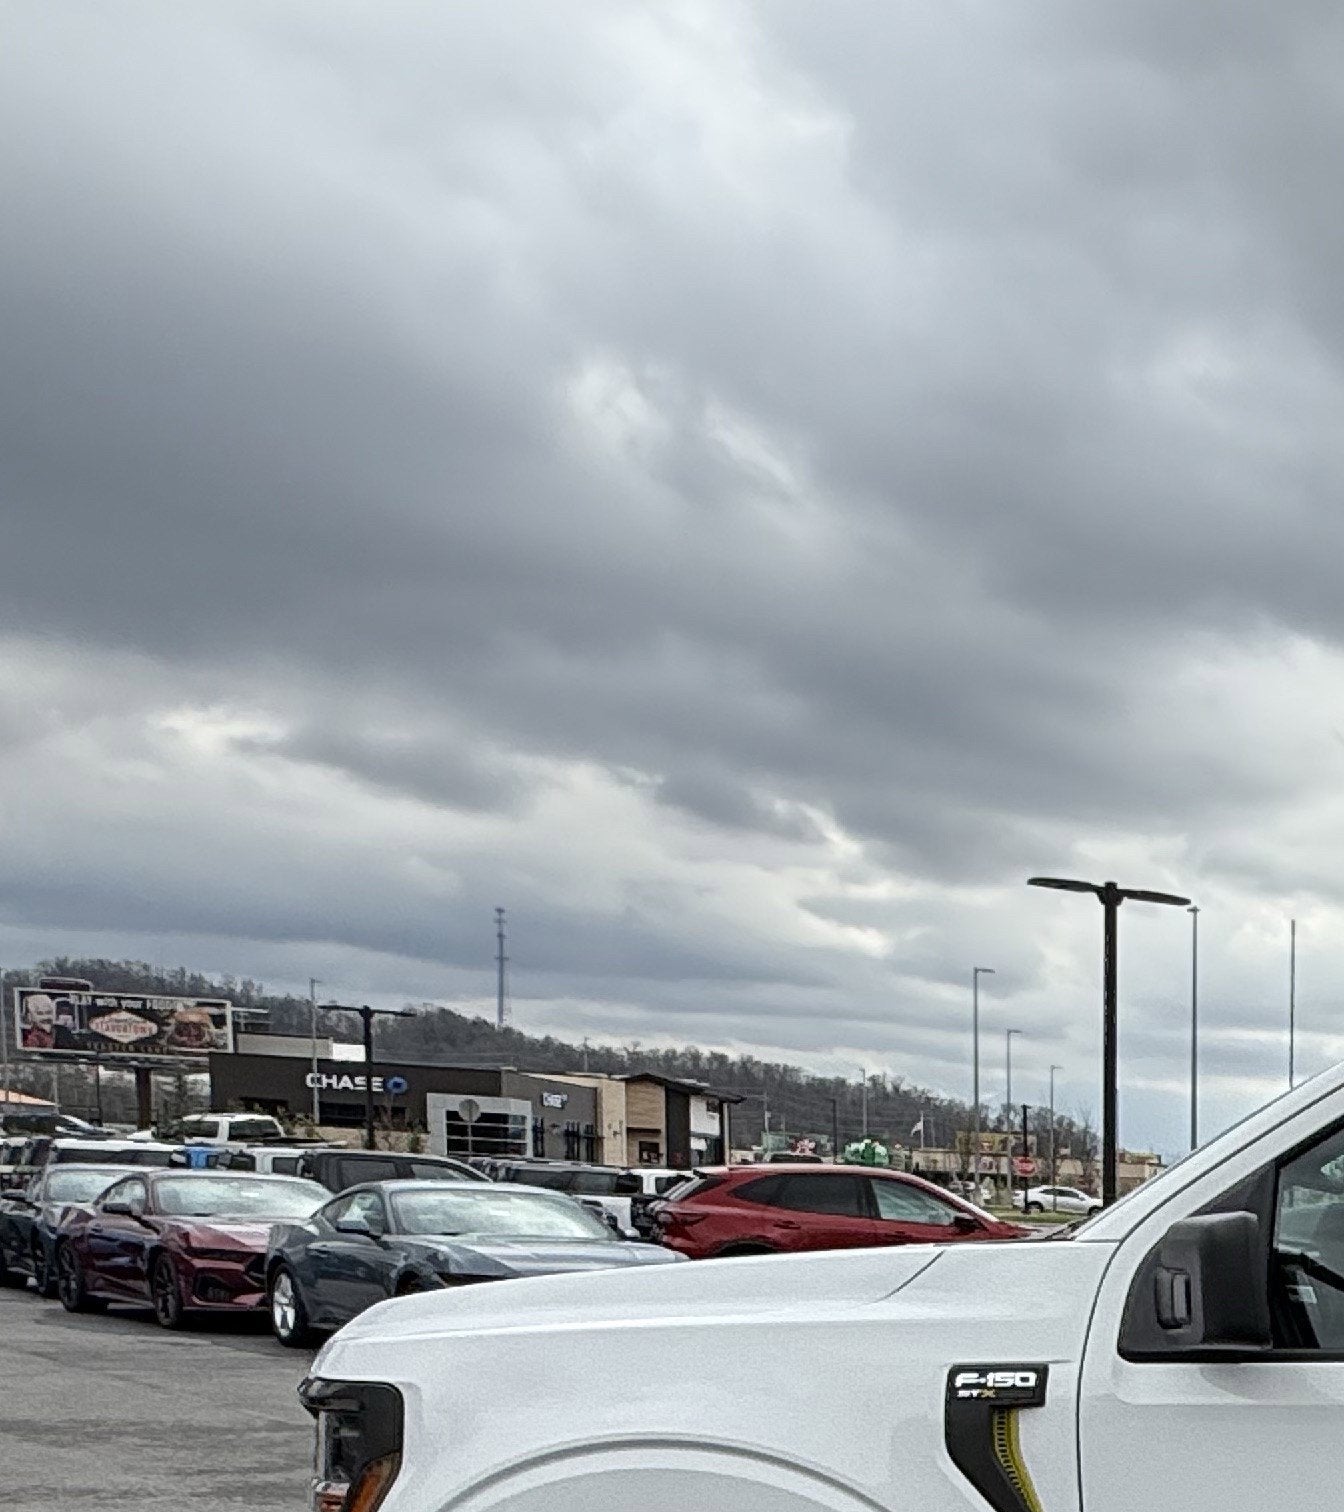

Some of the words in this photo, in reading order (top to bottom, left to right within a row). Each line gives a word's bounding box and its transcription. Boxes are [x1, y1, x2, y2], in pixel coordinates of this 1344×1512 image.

[304, 1073, 384, 1092] CHASE
[955, 1371, 1039, 1388] F-150
[957, 1388, 996, 1398] STX
